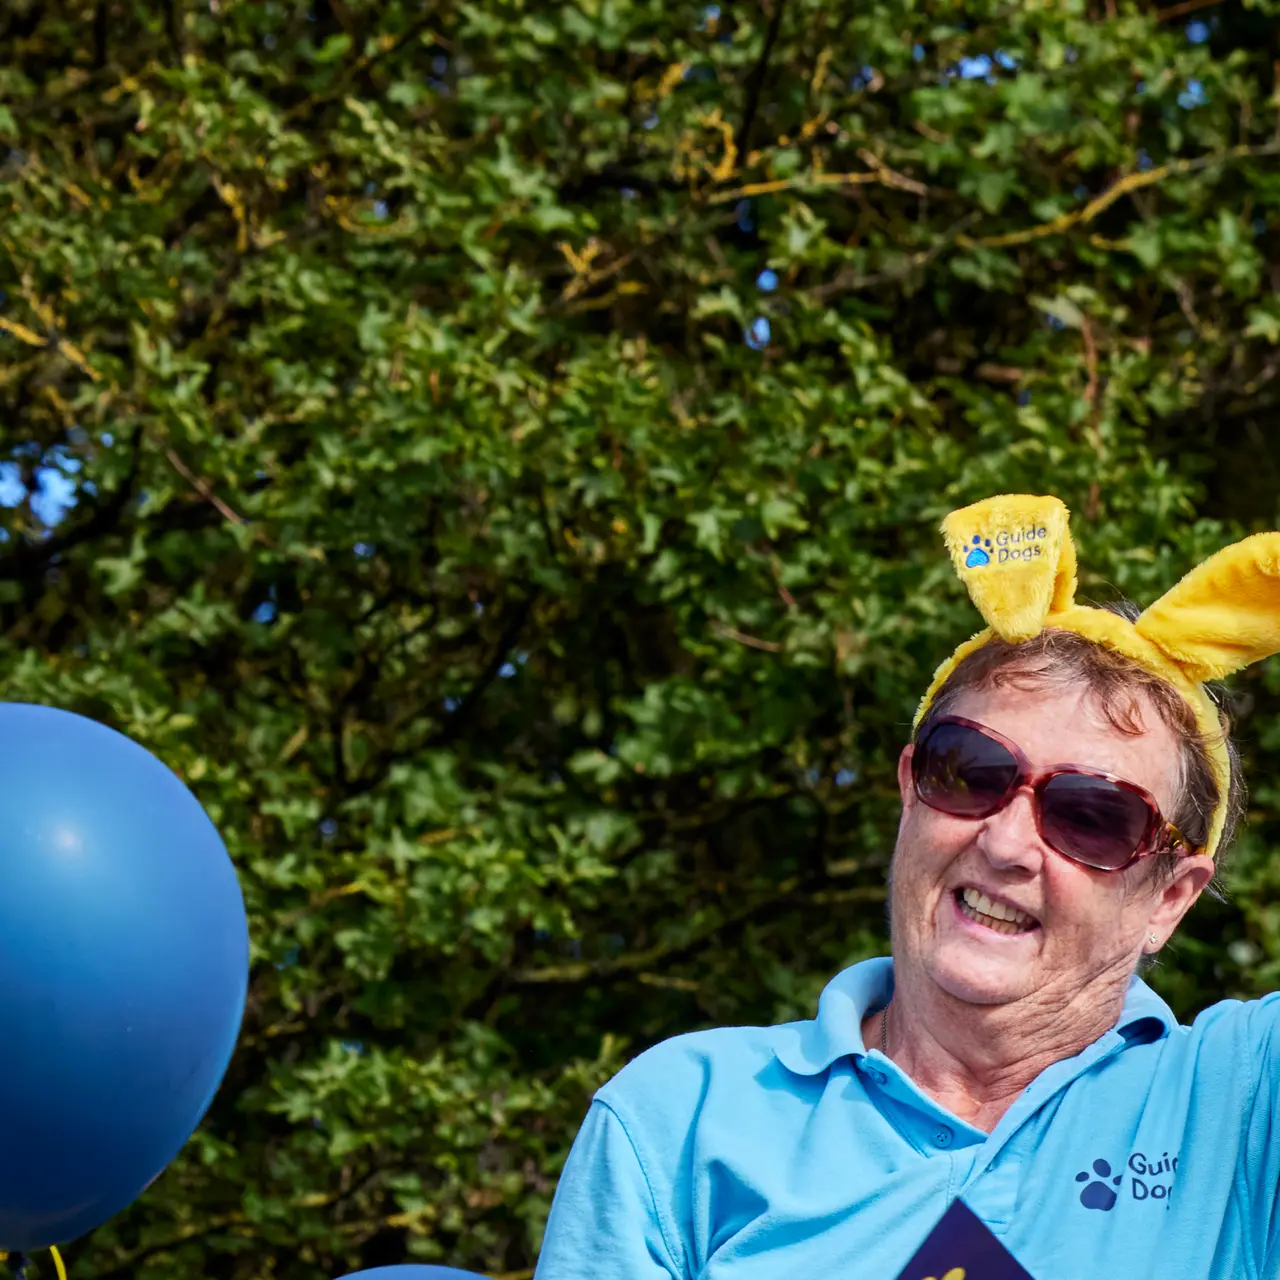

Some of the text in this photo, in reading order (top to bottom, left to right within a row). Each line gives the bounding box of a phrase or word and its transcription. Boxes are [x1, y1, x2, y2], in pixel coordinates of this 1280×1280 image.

[996, 524, 1047, 546] Guide
[998, 545, 1041, 562] Dogs
[1128, 1152, 1178, 1176] Gui
[1131, 1177, 1172, 1210] Do
